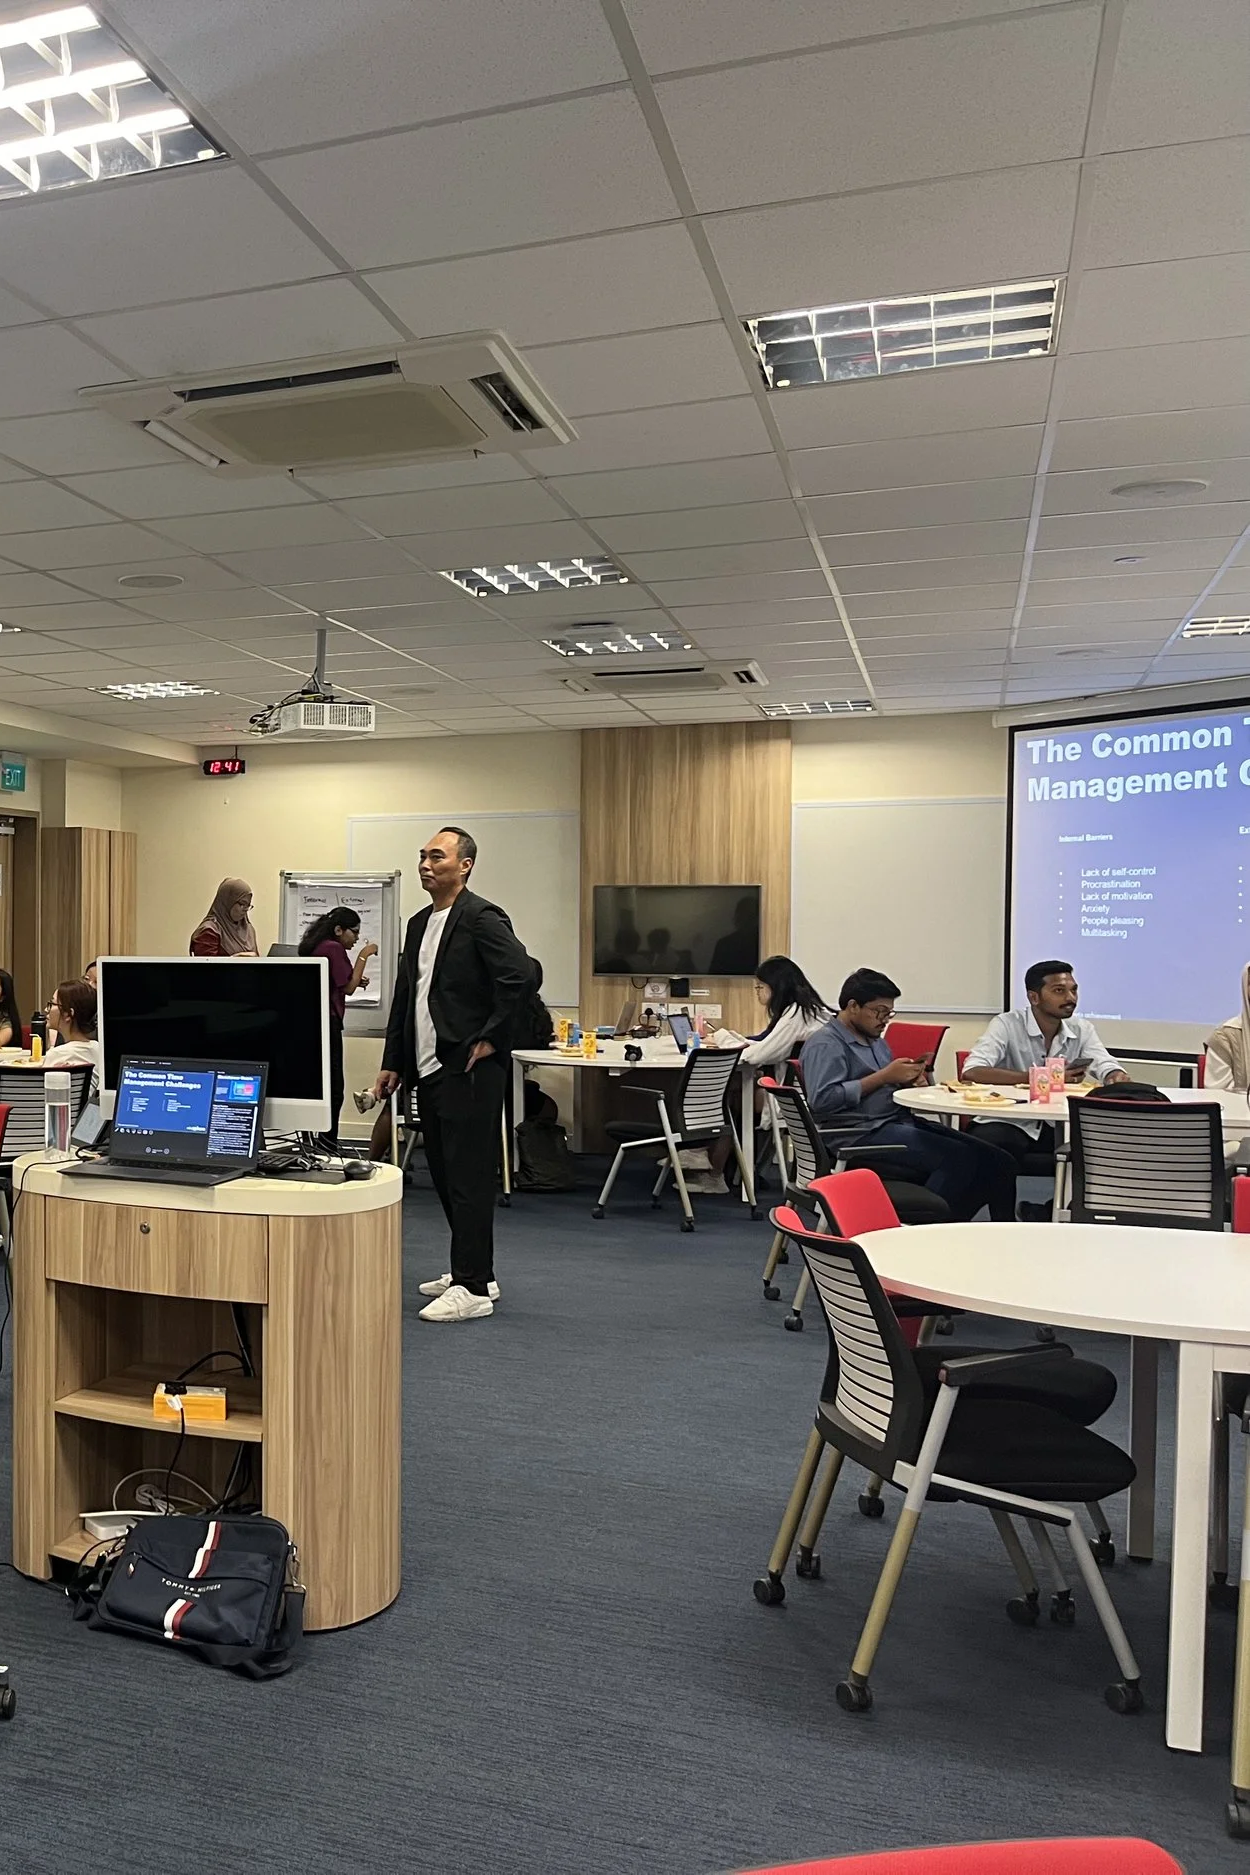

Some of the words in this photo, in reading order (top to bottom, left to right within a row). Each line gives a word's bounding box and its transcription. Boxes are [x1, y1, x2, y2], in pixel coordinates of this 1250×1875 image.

[1027, 740, 1082, 764] The
[1092, 726, 1232, 758] Common
[5, 768, 21, 787] EXIT
[1028, 762, 1228, 802] Management
[1085, 833, 1113, 841] Barriers
[1081, 868, 1100, 877] Lack
[1102, 867, 1111, 876] of
[1112, 866, 1156, 876] self-control
[1081, 880, 1141, 889] Procrastination
[1081, 892, 1100, 901] Lack
[1102, 892, 1111, 901] of
[1111, 892, 1153, 900] motivation
[1081, 904, 1110, 914] Anxiety
[1081, 916, 1108, 926] People
[1110, 916, 1144, 927] pleasing
[1081, 928, 1127, 939] Multitasking
[123, 1079, 164, 1087] Management
[165, 1081, 201, 1090] Challenges
[161, 1577, 189, 1591] TOMMY
